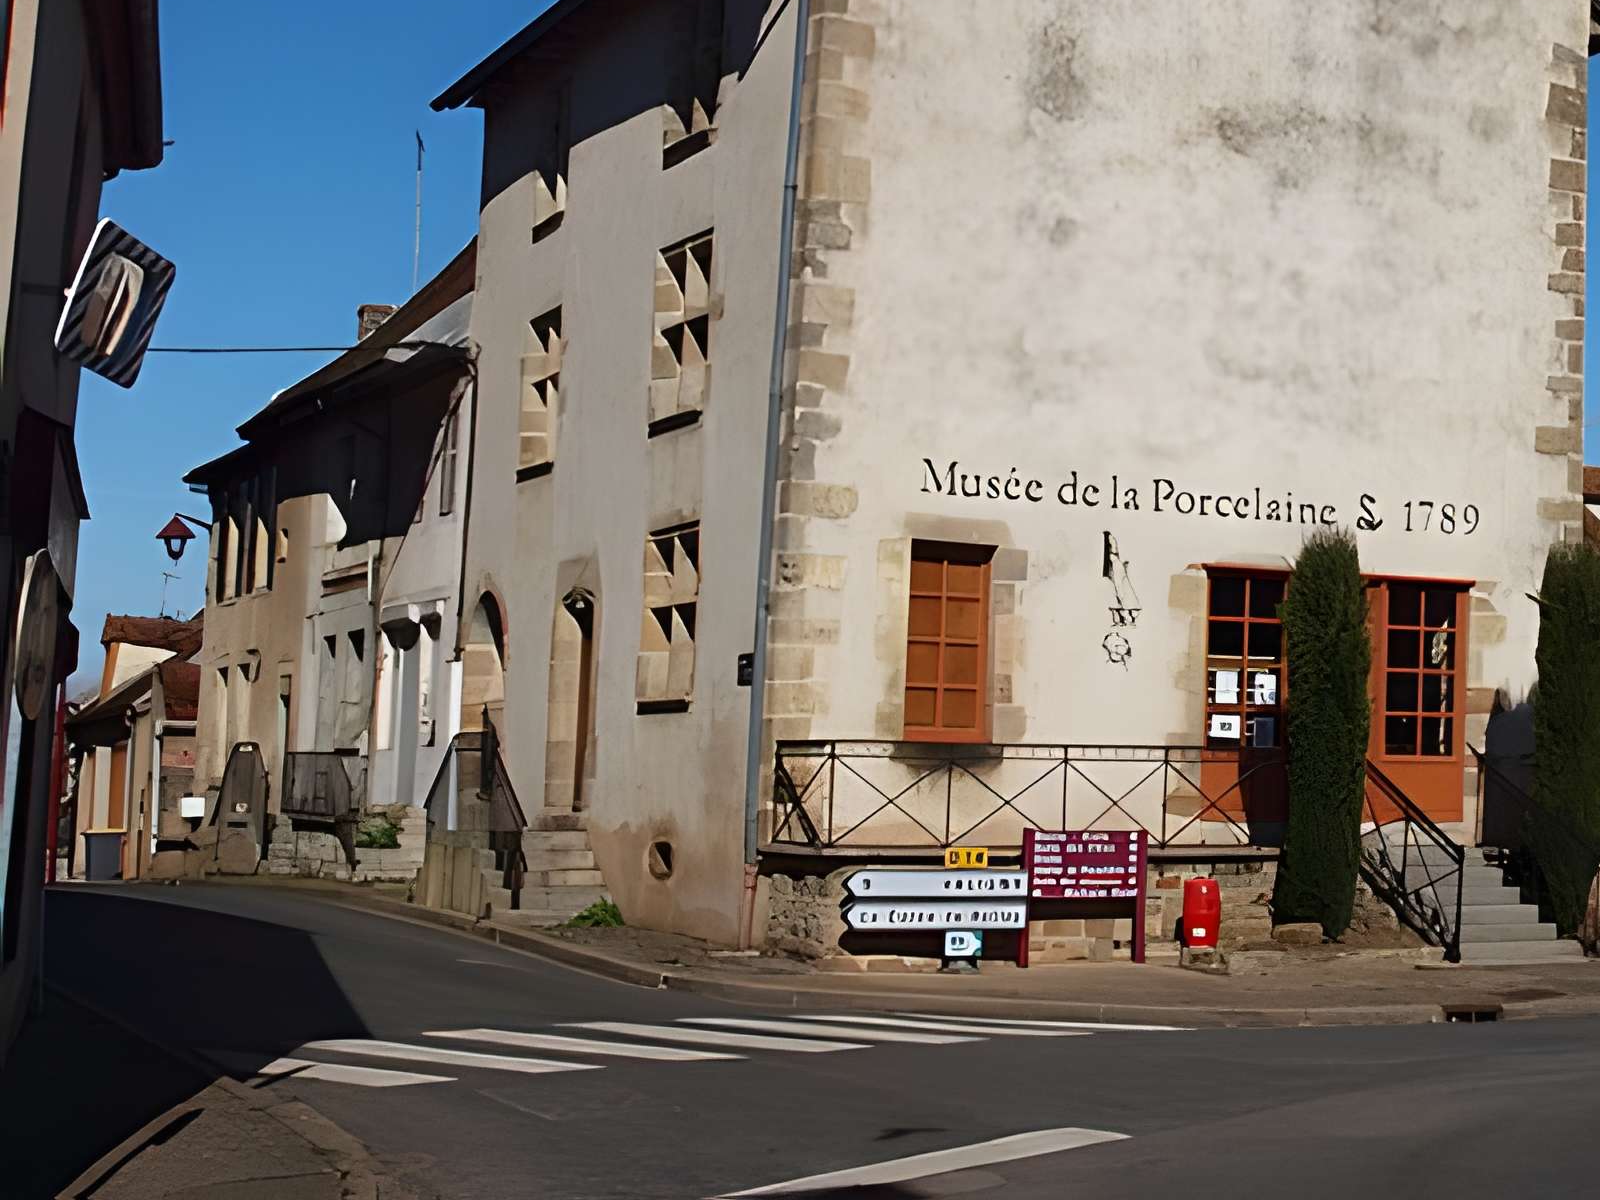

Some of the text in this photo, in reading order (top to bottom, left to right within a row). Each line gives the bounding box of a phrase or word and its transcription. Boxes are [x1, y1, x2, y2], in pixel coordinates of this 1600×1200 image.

[920, 457, 1044, 503] Musée
[1056, 470, 1100, 507] de
[1110, 474, 1140, 511] la
[1152, 477, 1338, 529] Porcelaine
[1402, 499, 1481, 536] 1789
